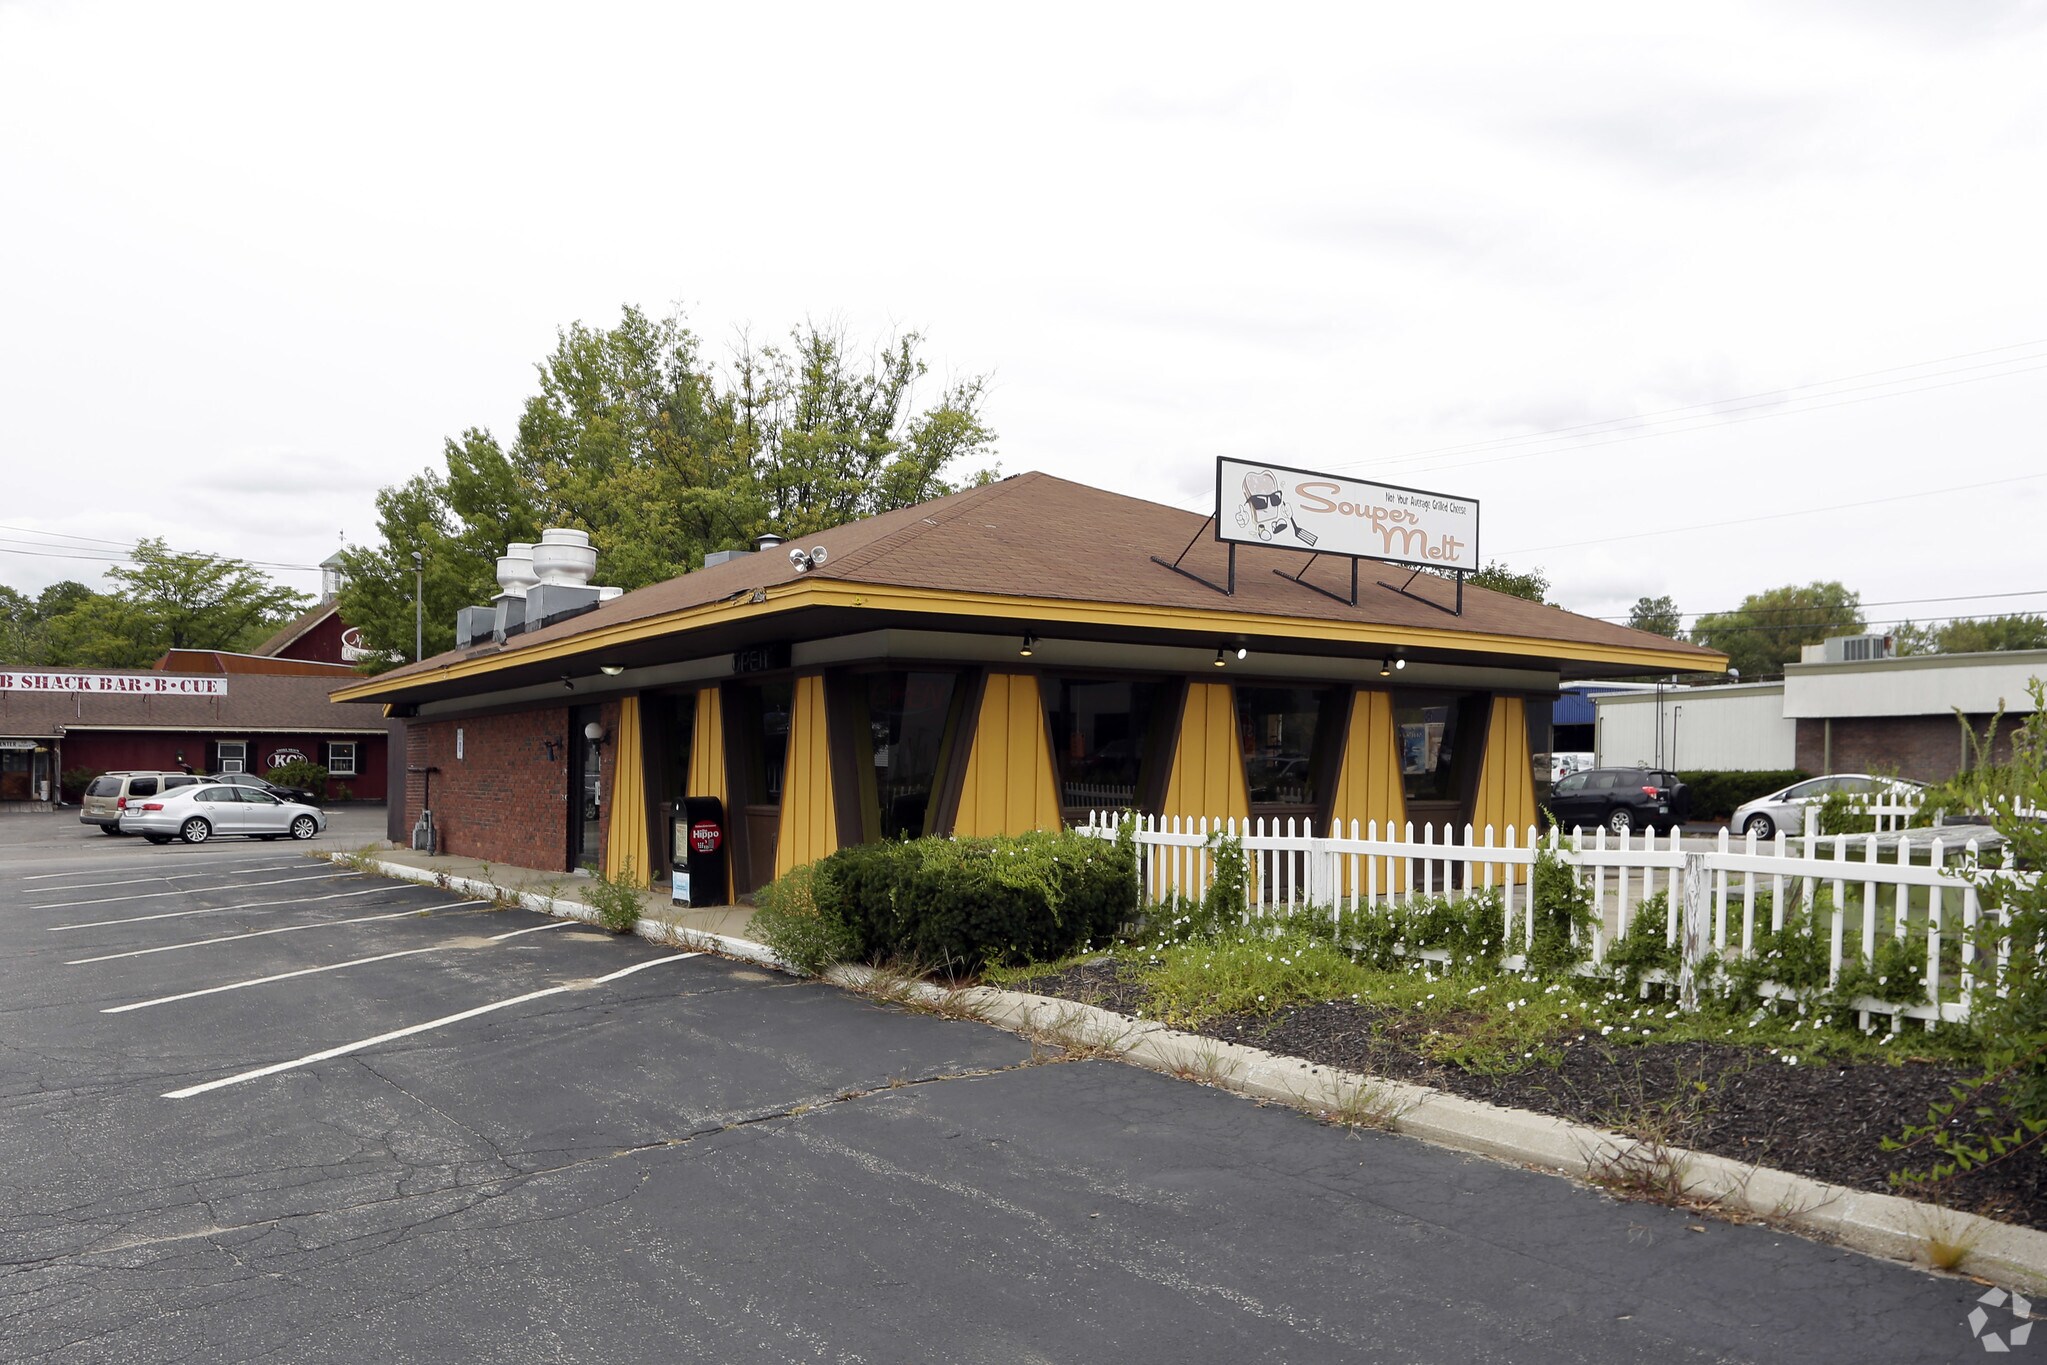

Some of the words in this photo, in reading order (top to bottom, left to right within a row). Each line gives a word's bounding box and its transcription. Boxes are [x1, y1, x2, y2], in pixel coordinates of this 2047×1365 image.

[1295, 482, 1419, 534] Souper
[1385, 492, 1395, 503] Not
[1397, 494, 1409, 505] Your
[1410, 496, 1431, 512] Average
[1432, 499, 1449, 512] Grilled
[1449, 502, 1467, 515] Cheese
[1374, 524, 1465, 561] Melt
[21, 675, 92, 690] SHACK
[693, 830, 719, 839] Hippo
